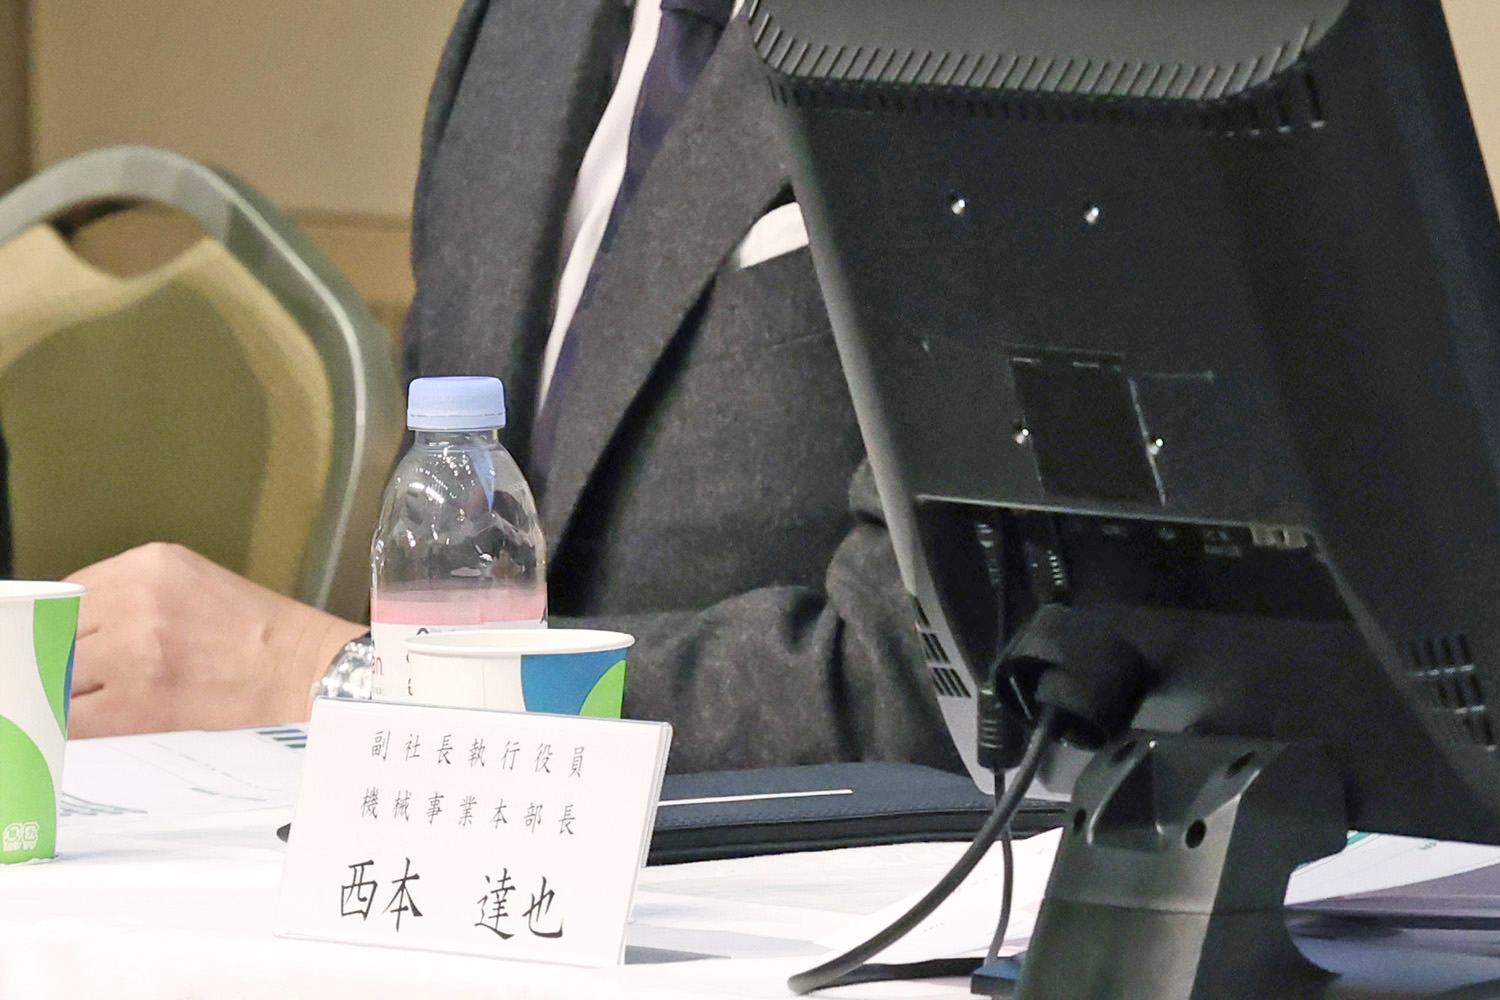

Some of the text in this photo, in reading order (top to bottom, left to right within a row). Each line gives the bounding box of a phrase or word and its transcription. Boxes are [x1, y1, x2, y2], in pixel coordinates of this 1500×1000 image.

[371, 730, 586, 778] 副社長執行役員
[359, 786, 577, 836] 機械事業本部長
[340, 857, 564, 940] 西本 達也
